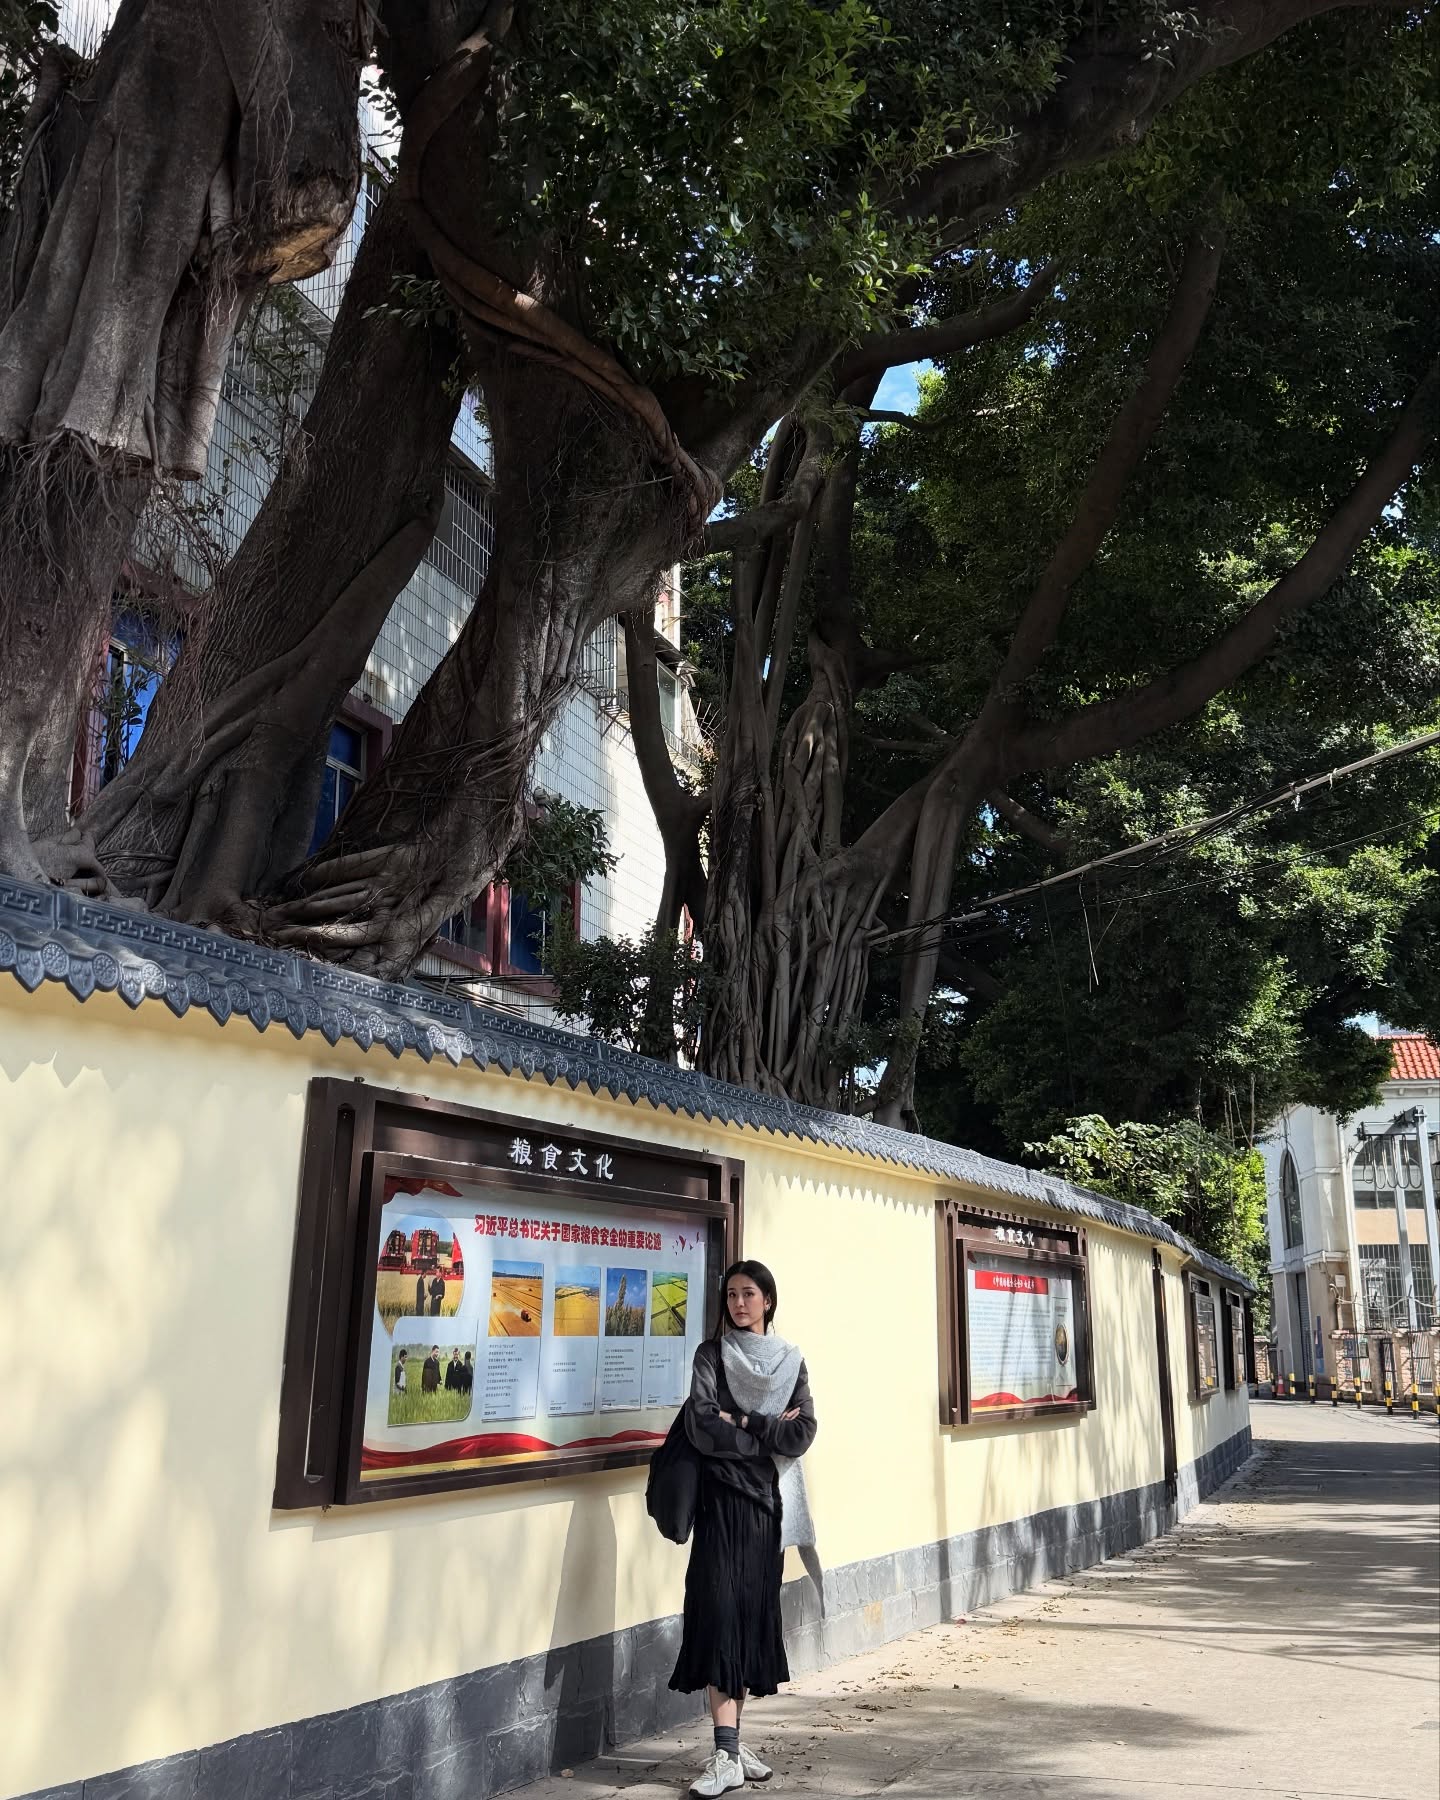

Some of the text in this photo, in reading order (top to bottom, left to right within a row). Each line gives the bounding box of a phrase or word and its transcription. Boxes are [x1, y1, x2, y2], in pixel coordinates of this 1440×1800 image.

[508, 1137, 614, 1180] 粮食文化
[474, 1214, 662, 1251] 习近平总书记关于国家粮食安全的重要论述
